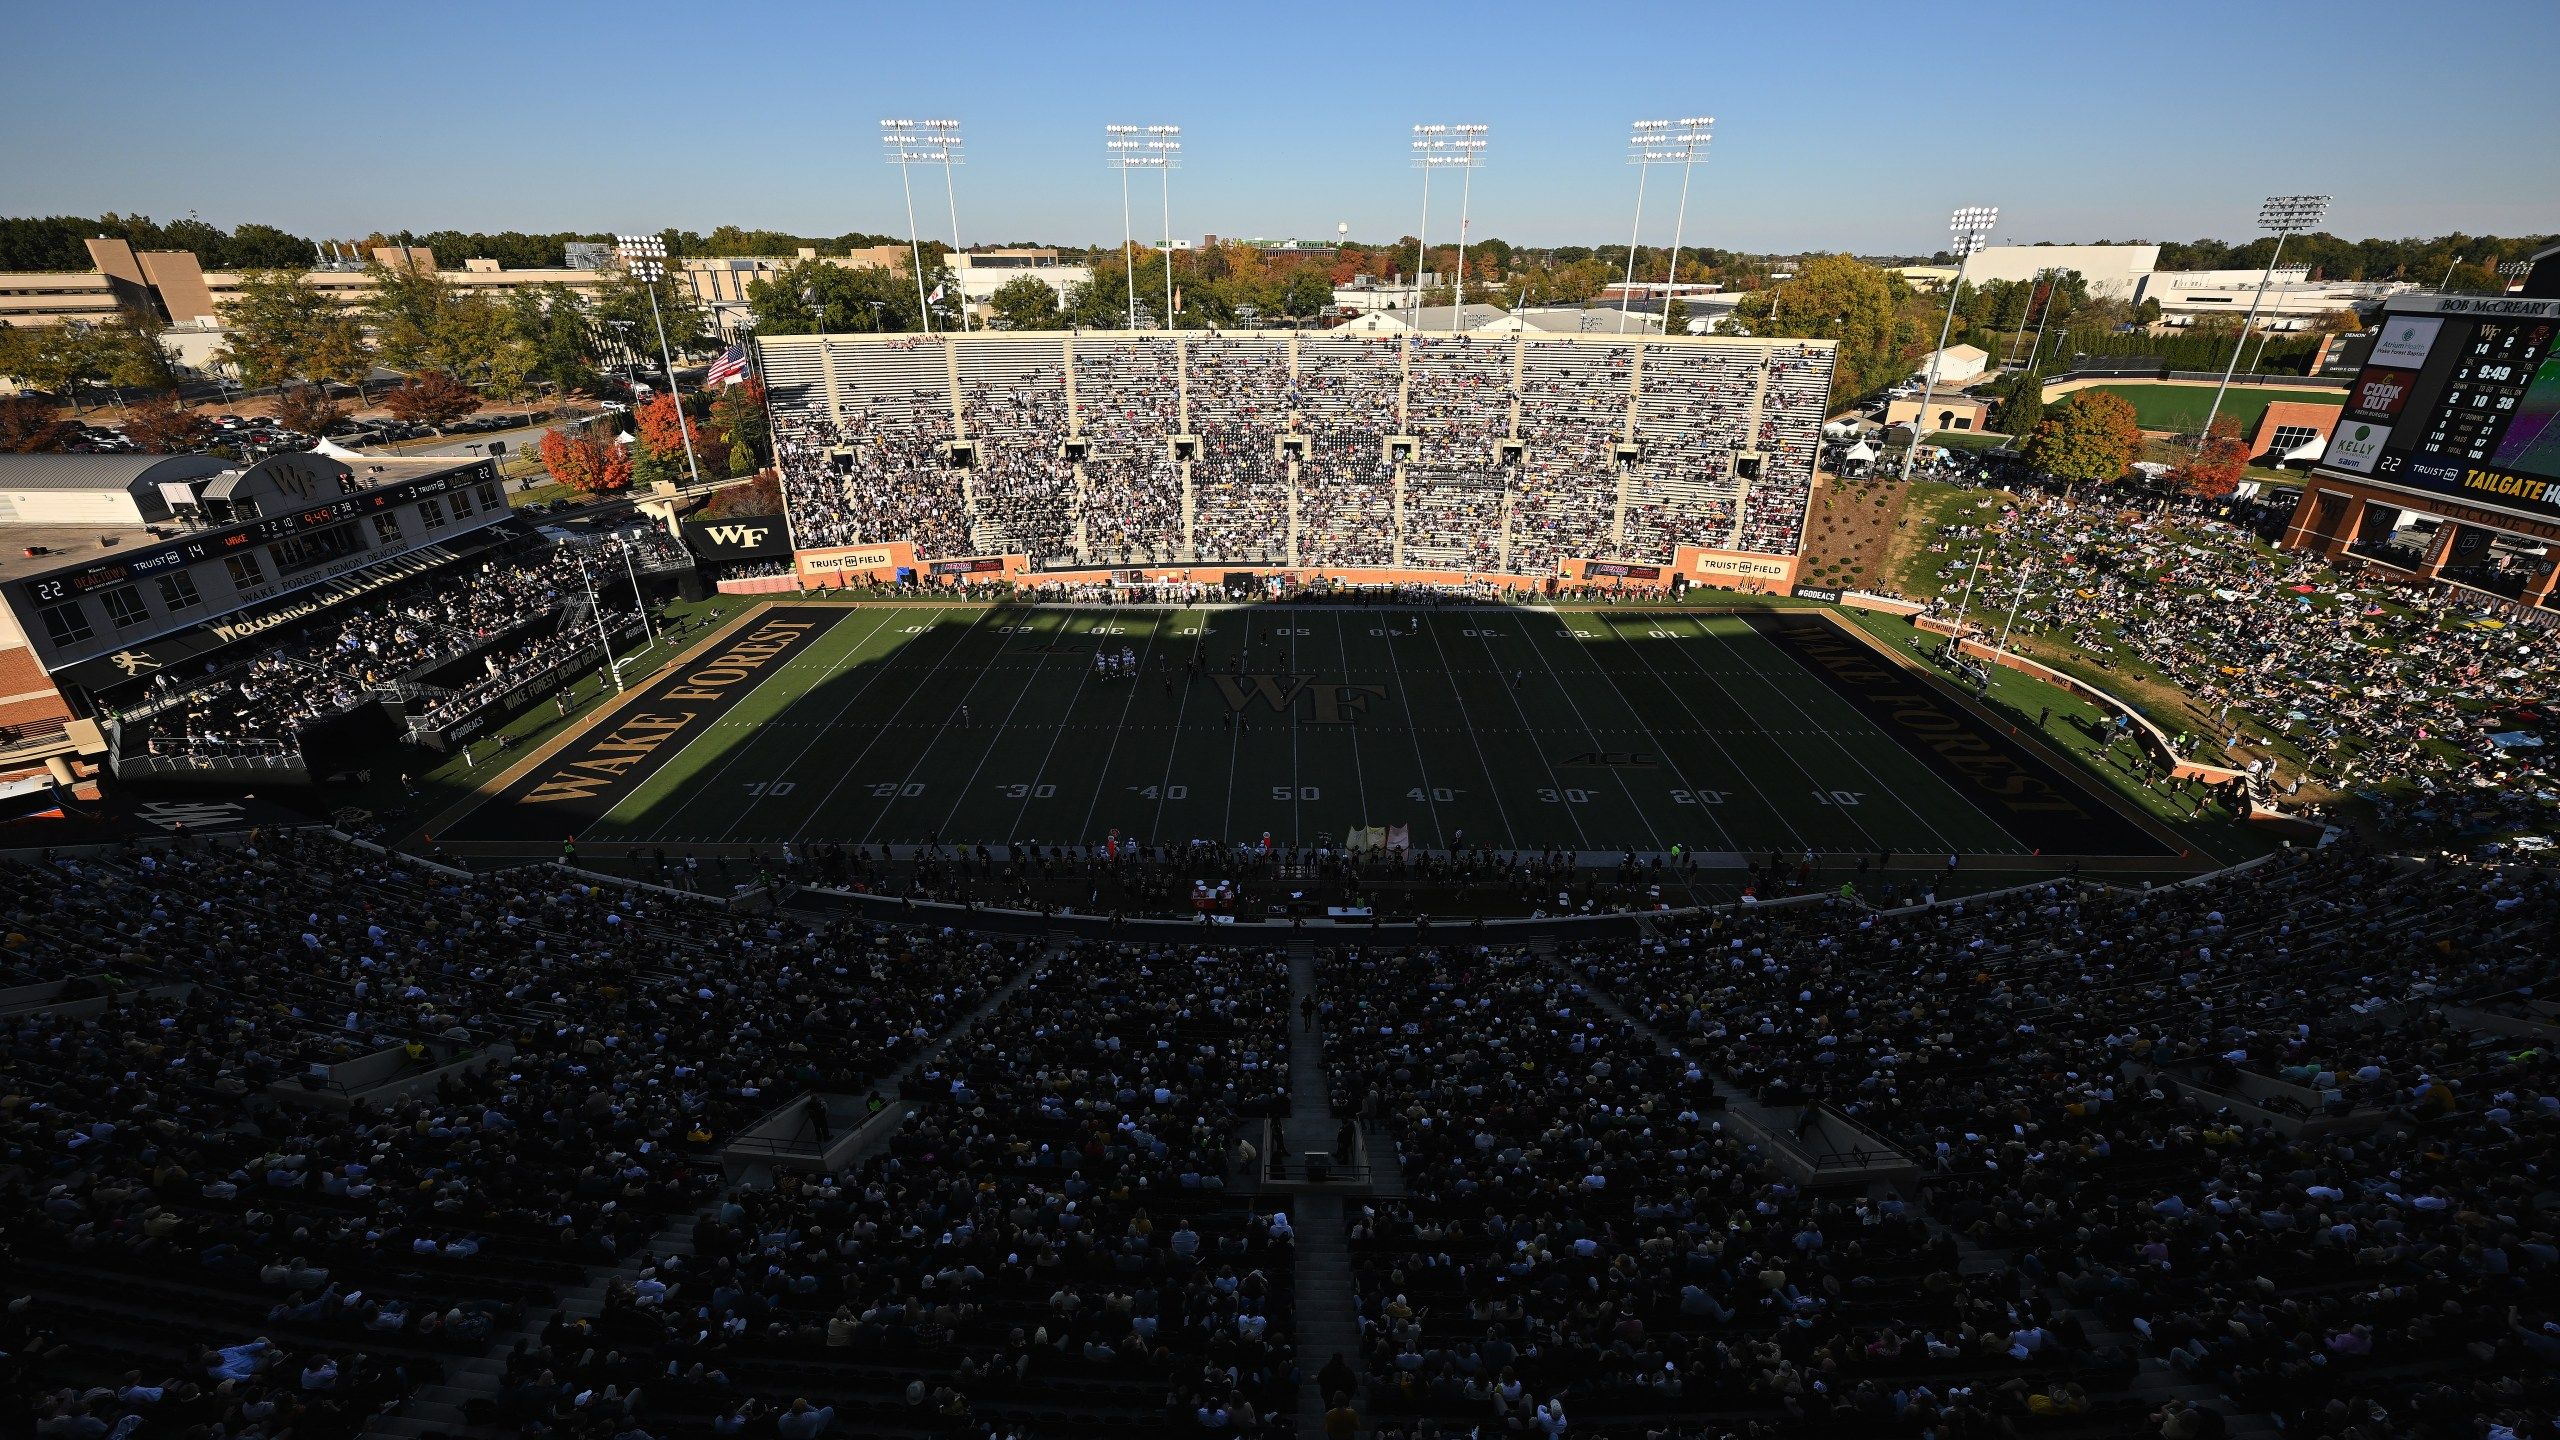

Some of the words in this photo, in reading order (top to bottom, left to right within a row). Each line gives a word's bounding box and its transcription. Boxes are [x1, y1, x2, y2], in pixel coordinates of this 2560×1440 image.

[2441, 299, 2469, 311] BOB
[2473, 300, 2551, 315] McCREARY
[2383, 341, 2405, 349] Atrium
[2405, 342, 2425, 350] Health
[2475, 343, 2490, 355] 14
[2504, 336, 2514, 348] 2
[2525, 347, 2536, 358] 3
[2459, 369, 2468, 379] 3
[2478, 365, 2511, 380] 9:49
[2520, 374, 2527, 385] 1
[2362, 382, 2403, 399] COOK
[2362, 396, 2392, 411] OUT
[2449, 392, 2459, 404] 2
[2472, 395, 2488, 408] 10
[2496, 397, 2515, 410] 38
[2369, 411, 2390, 419] BURGERS
[2445, 410, 2452, 418] 9
[2488, 415, 2496, 424] 8
[2440, 421, 2447, 429] 8
[2481, 427, 2493, 435] 21
[2430, 432, 2445, 441] 110
[2474, 439, 2487, 447] 87
[2337, 440, 2375, 455] KELLY
[2425, 443, 2440, 452] 118
[2468, 450, 2483, 459] 108
[2380, 456, 2401, 472] 22
[2413, 464, 2445, 477] TRUIST
[478, 467, 490, 479] 22
[264, 463, 317, 501] WF
[418, 483, 438, 494] TRUIST
[409, 486, 417, 498] 3
[332, 505, 338, 515] 2
[340, 502, 351, 513] 38
[283, 517, 293, 527] 10
[304, 509, 331, 525] 9:49
[2429, 500, 2521, 531] WELCOME
[2530, 522, 2557, 538] TO
[260, 524, 266, 532] 3
[271, 521, 278, 531] 2
[224, 533, 248, 546] WAKE
[704, 524, 769, 548] WF
[188, 544, 204, 559] 14
[133, 556, 166, 571] TRUIST
[809, 559, 843, 569] TRUIST
[858, 554, 886, 565] FIELD
[1704, 560, 1738, 571] TRUIST
[1753, 565, 1782, 575] FIELD
[73, 565, 128, 590] DEACTOWN
[241, 585, 276, 604] WAKE
[282, 570, 322, 592] FOREST
[327, 557, 364, 576] DEMON
[367, 542, 409, 562] DEACONS
[38, 580, 64, 600] 22
[1798, 588, 1835, 601] #GODEACS
[203, 603, 317, 643] Welcome
[312, 591, 343, 606] to
[660, 619, 816, 701] FOREST
[2051, 673, 2069, 688] WAKE
[450, 717, 484, 742] #GODEACS
[503, 684, 528, 711] WAKE
[529, 671, 557, 697] FOREST
[557, 656, 581, 681] DEMON
[1204, 673, 1389, 725] WF
[518, 712, 697, 804] WAKE
[1558, 751, 1658, 768] ACC
[1866, 694, 2094, 821] FOREST
[748, 782, 797, 796] 10
[872, 783, 926, 797] 20
[1006, 784, 1057, 798] 30
[1139, 785, 1188, 799] 40
[1272, 786, 1321, 801] 50
[1405, 787, 1455, 802] 40
[1536, 787, 1590, 803] 30
[1669, 788, 1724, 804] 20
[1811, 790, 1860, 806] 10
